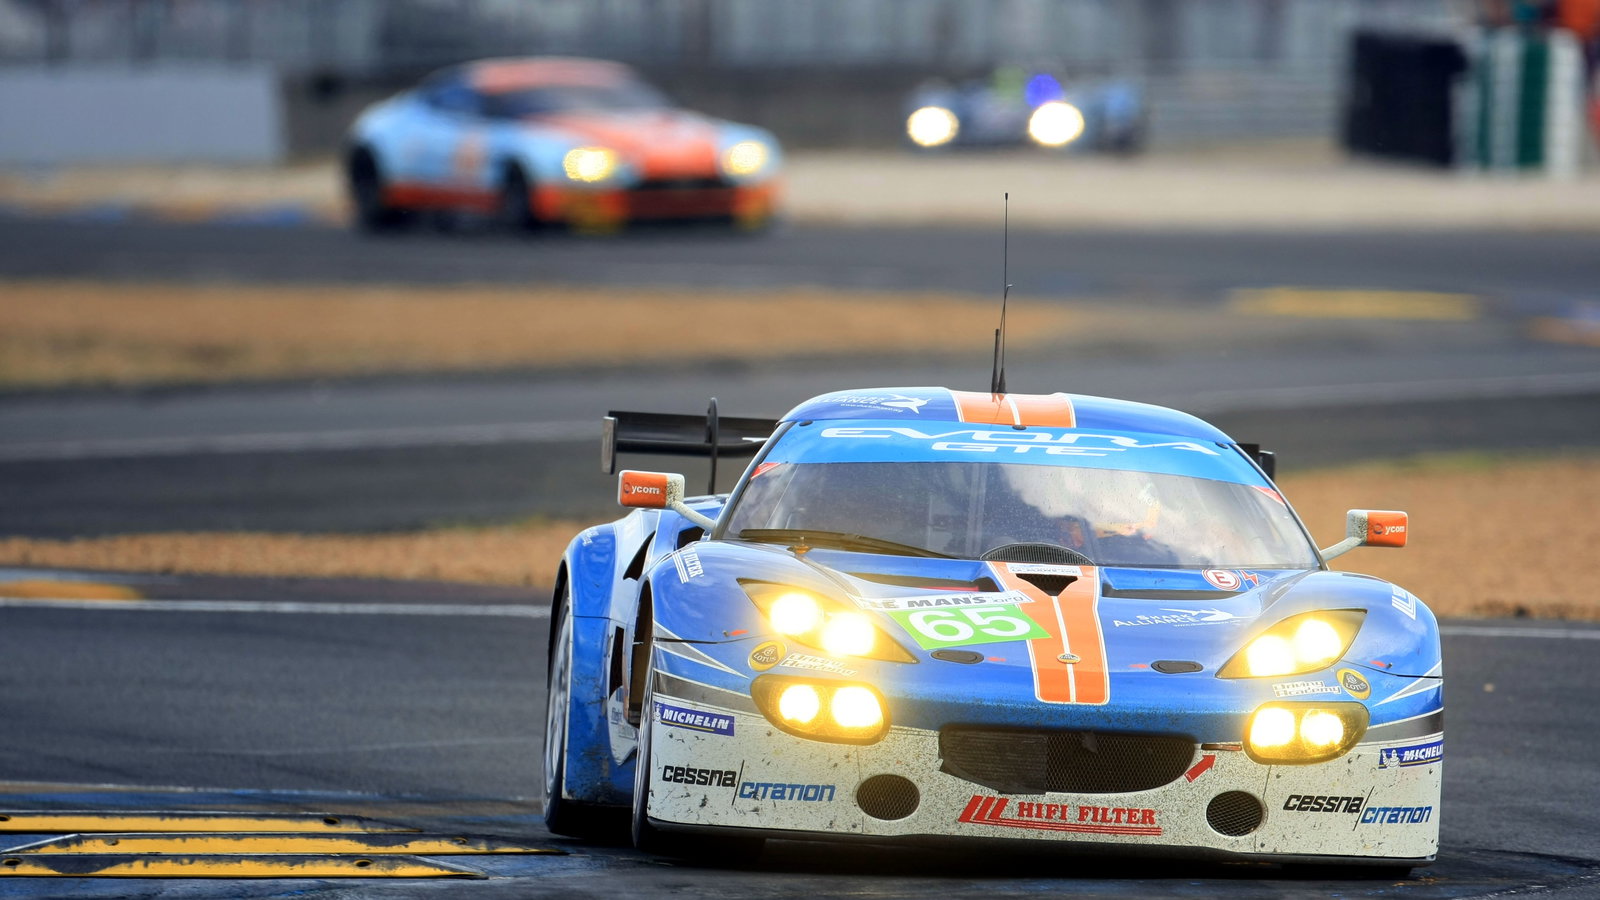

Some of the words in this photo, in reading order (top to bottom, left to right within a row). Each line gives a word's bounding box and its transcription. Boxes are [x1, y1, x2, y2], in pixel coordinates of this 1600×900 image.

[819, 427, 1221, 456] EVORA
[931, 441, 1127, 456] GTE
[631, 485, 660, 495] ycom
[1212, 571, 1231, 585] E
[907, 596, 987, 608] MANS
[908, 607, 1031, 642] 65
[1113, 617, 1200, 627] ALLIANCE
[753, 652, 777, 663] LOTUS
[1346, 682, 1367, 691] LOTUS
[662, 708, 730, 730] MICHELIN
[1402, 744, 1444, 762] MICHELI
[1017, 801, 1069, 820] HIFI
[1077, 805, 1156, 825] FILTER
